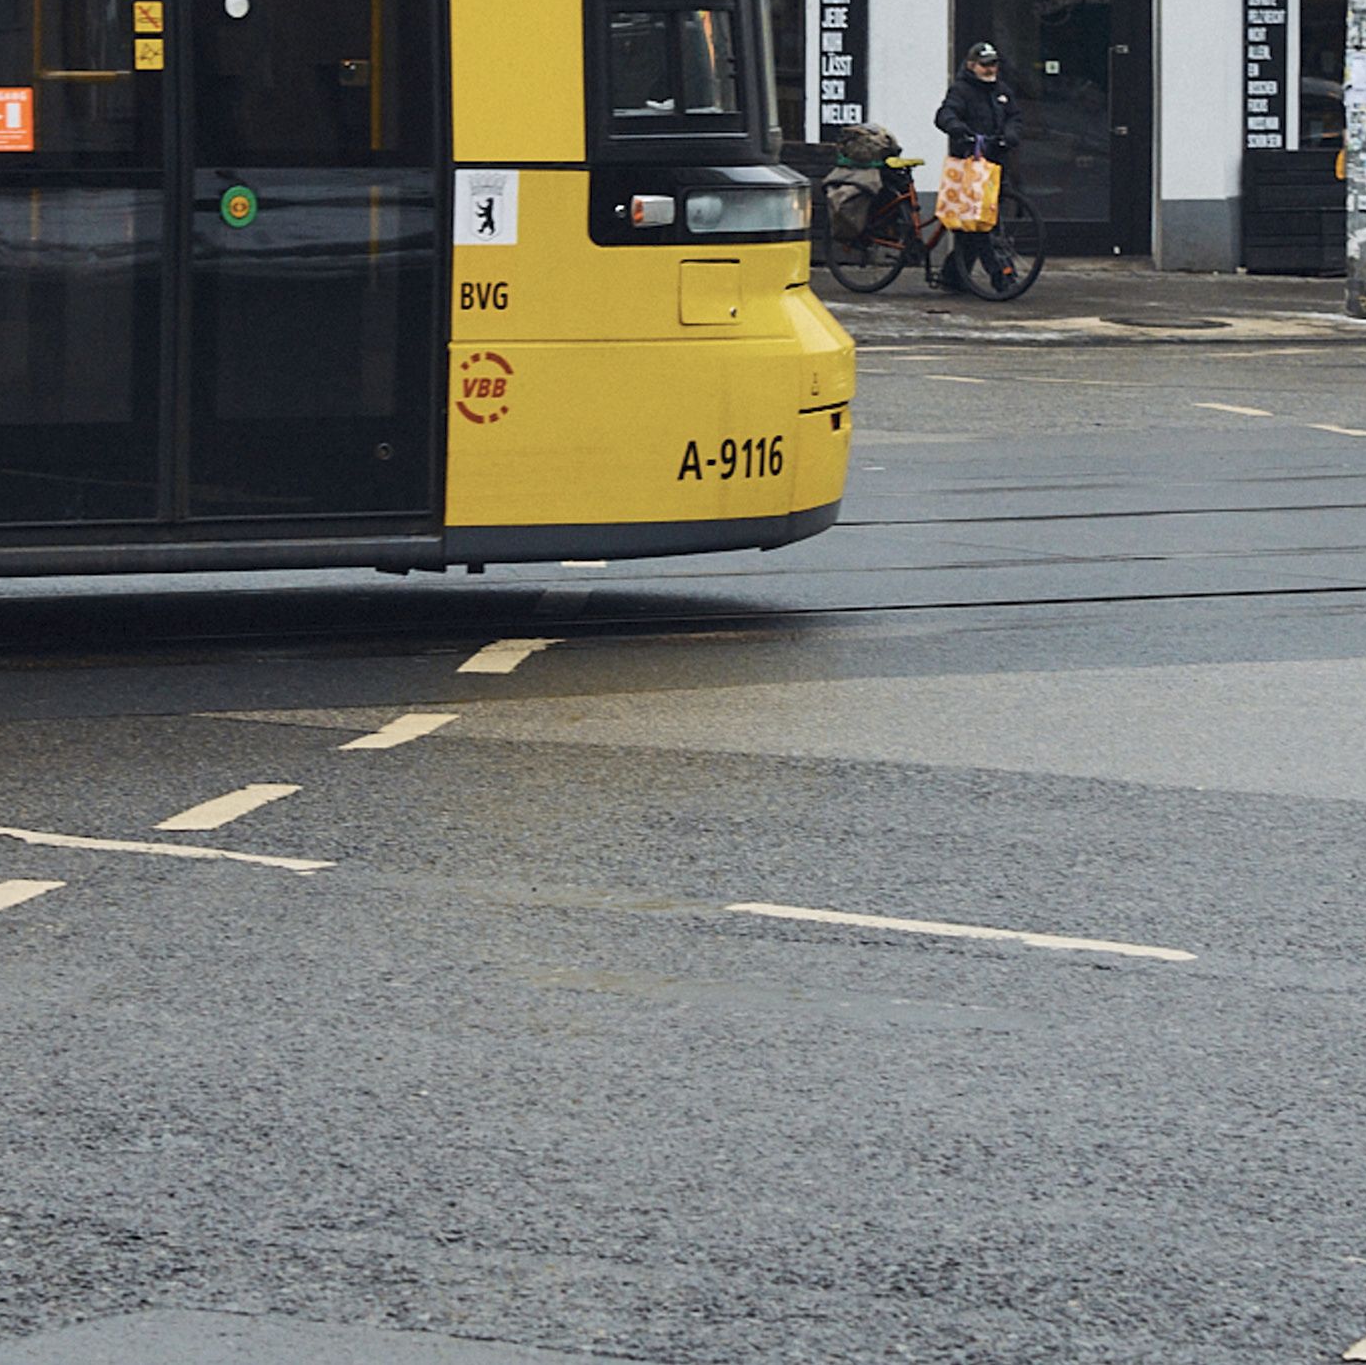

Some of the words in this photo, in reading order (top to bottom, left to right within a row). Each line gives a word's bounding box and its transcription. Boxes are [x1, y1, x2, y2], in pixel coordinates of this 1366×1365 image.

[821, 7, 849, 28] JEDE
[821, 53, 853, 76] LÄSST
[459, 282, 509, 310] BVG
[462, 377, 507, 398] VBB
[677, 435, 784, 481] A-9116
